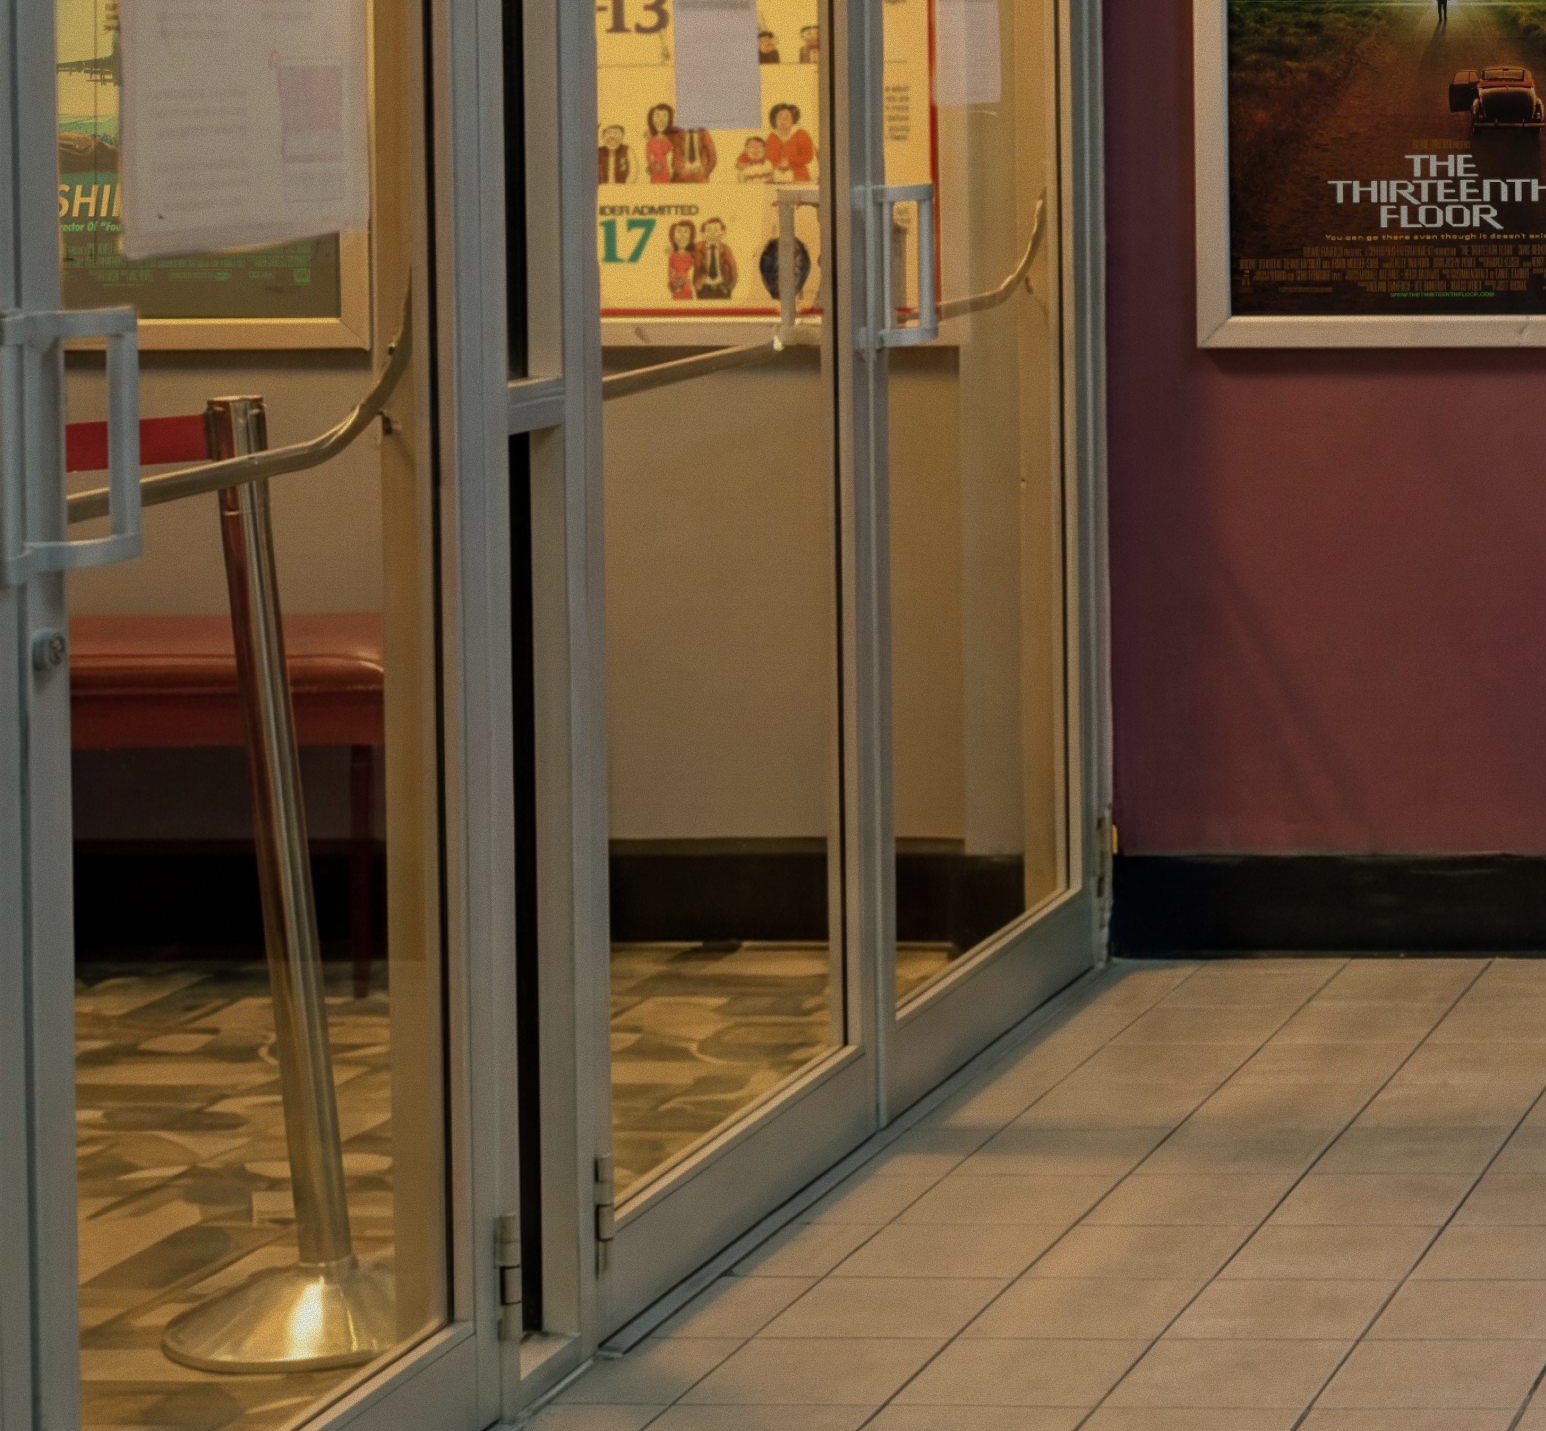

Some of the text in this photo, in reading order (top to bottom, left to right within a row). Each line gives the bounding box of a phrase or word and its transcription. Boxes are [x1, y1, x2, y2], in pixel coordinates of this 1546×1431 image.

[1405, 155, 1479, 177] THE
[599, 205, 699, 216] DER ADMITTED
[1380, 205, 1504, 230] FLOOR
[60, 223, 85, 231] rector
[600, 218, 656, 262] 17
